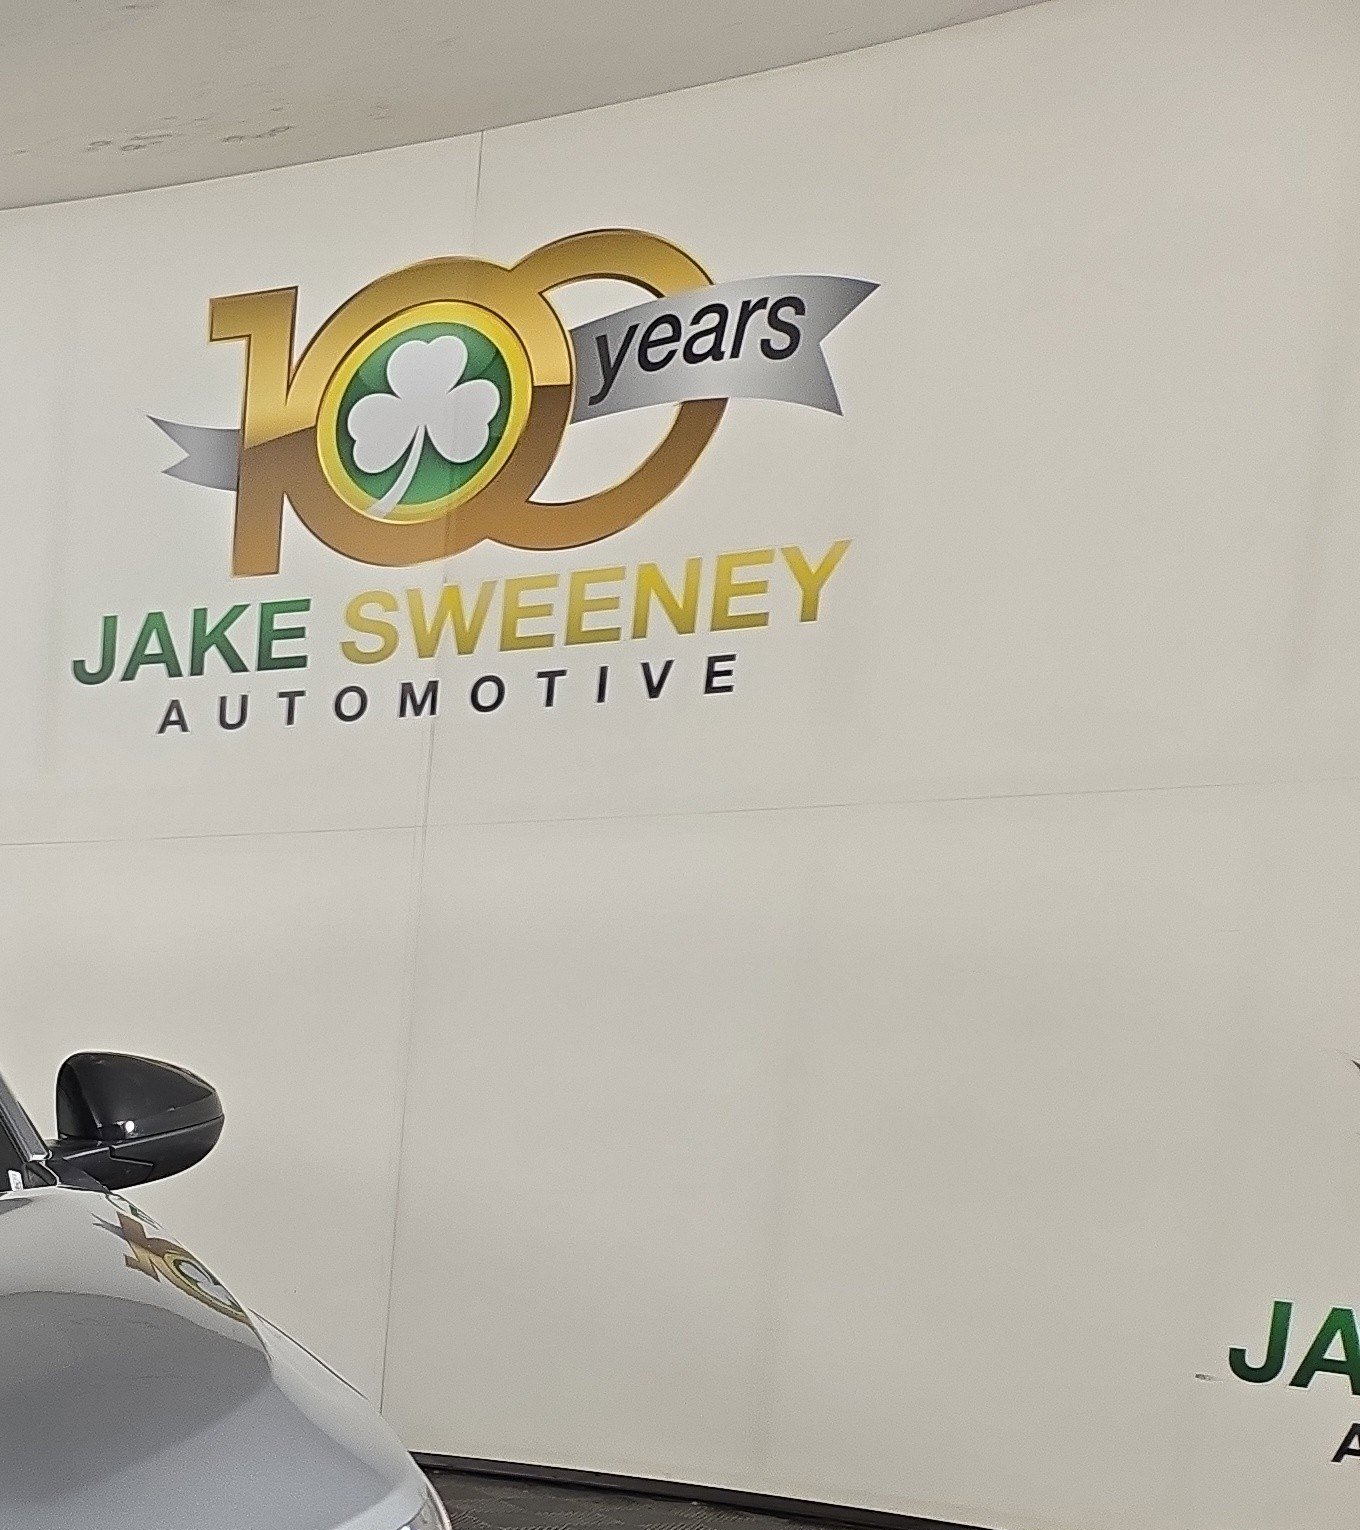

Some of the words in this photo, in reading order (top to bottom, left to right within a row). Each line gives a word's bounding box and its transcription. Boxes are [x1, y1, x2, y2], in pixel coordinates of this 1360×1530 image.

[208, 228, 728, 577] 100
[589, 295, 806, 406] years
[72, 598, 312, 685] JAKE
[340, 540, 851, 665] SWEENEY
[157, 653, 737, 734] AUTOMOTIVE
